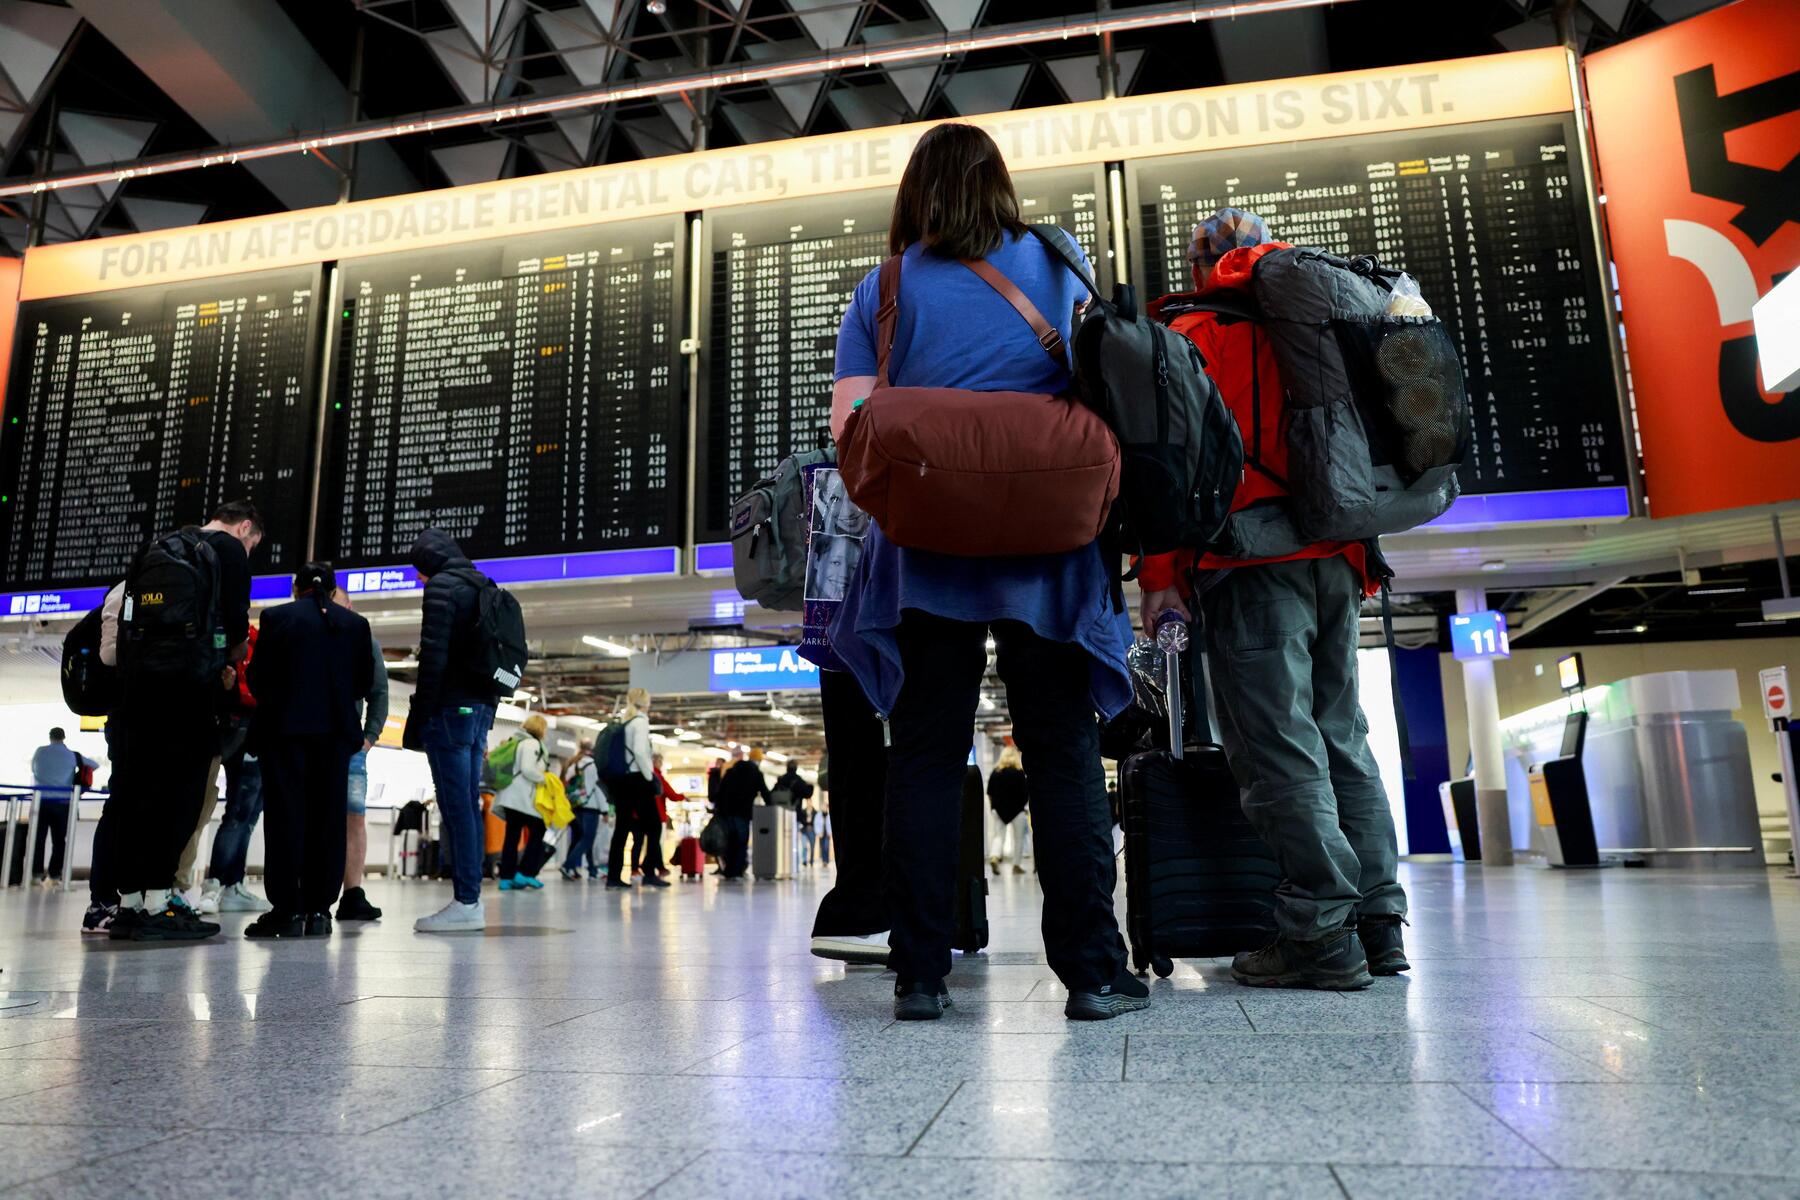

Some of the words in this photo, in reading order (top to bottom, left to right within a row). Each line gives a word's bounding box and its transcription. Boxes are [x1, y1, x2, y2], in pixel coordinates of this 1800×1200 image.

[99, 239, 167, 281] FOR
[179, 231, 231, 270] AN
[242, 199, 494, 262] AFFORDABLE
[508, 171, 669, 223] RENTAL
[684, 154, 788, 199] CAR,
[804, 138, 891, 183] THE
[906, 97, 1239, 160] TINATION
[1256, 90, 1304, 132] IS
[1320, 74, 1454, 125] SIXT.
[1162, 202, 1176, 212] LH
[1228, 184, 1357, 206] GOETEBORG-CANCELLED
[1243, 203, 1276, 215] LLUND
[1265, 207, 1366, 225] HEN-WUERZBURG-N
[1269, 221, 1340, 236] -CANCELLED
[790, 291, 856, 306] DORTMUND-K
[790, 302, 849, 317] HAMBURG-M
[790, 314, 844, 328] LONDON-C
[790, 325, 844, 338] MUENCHEN
[789, 406, 837, 418] STUTTGA
[789, 430, 819, 441] PARI
[789, 442, 819, 453] PARI
[1470, 629, 1495, 654] 11
[493, 667, 520, 689] PUMA
